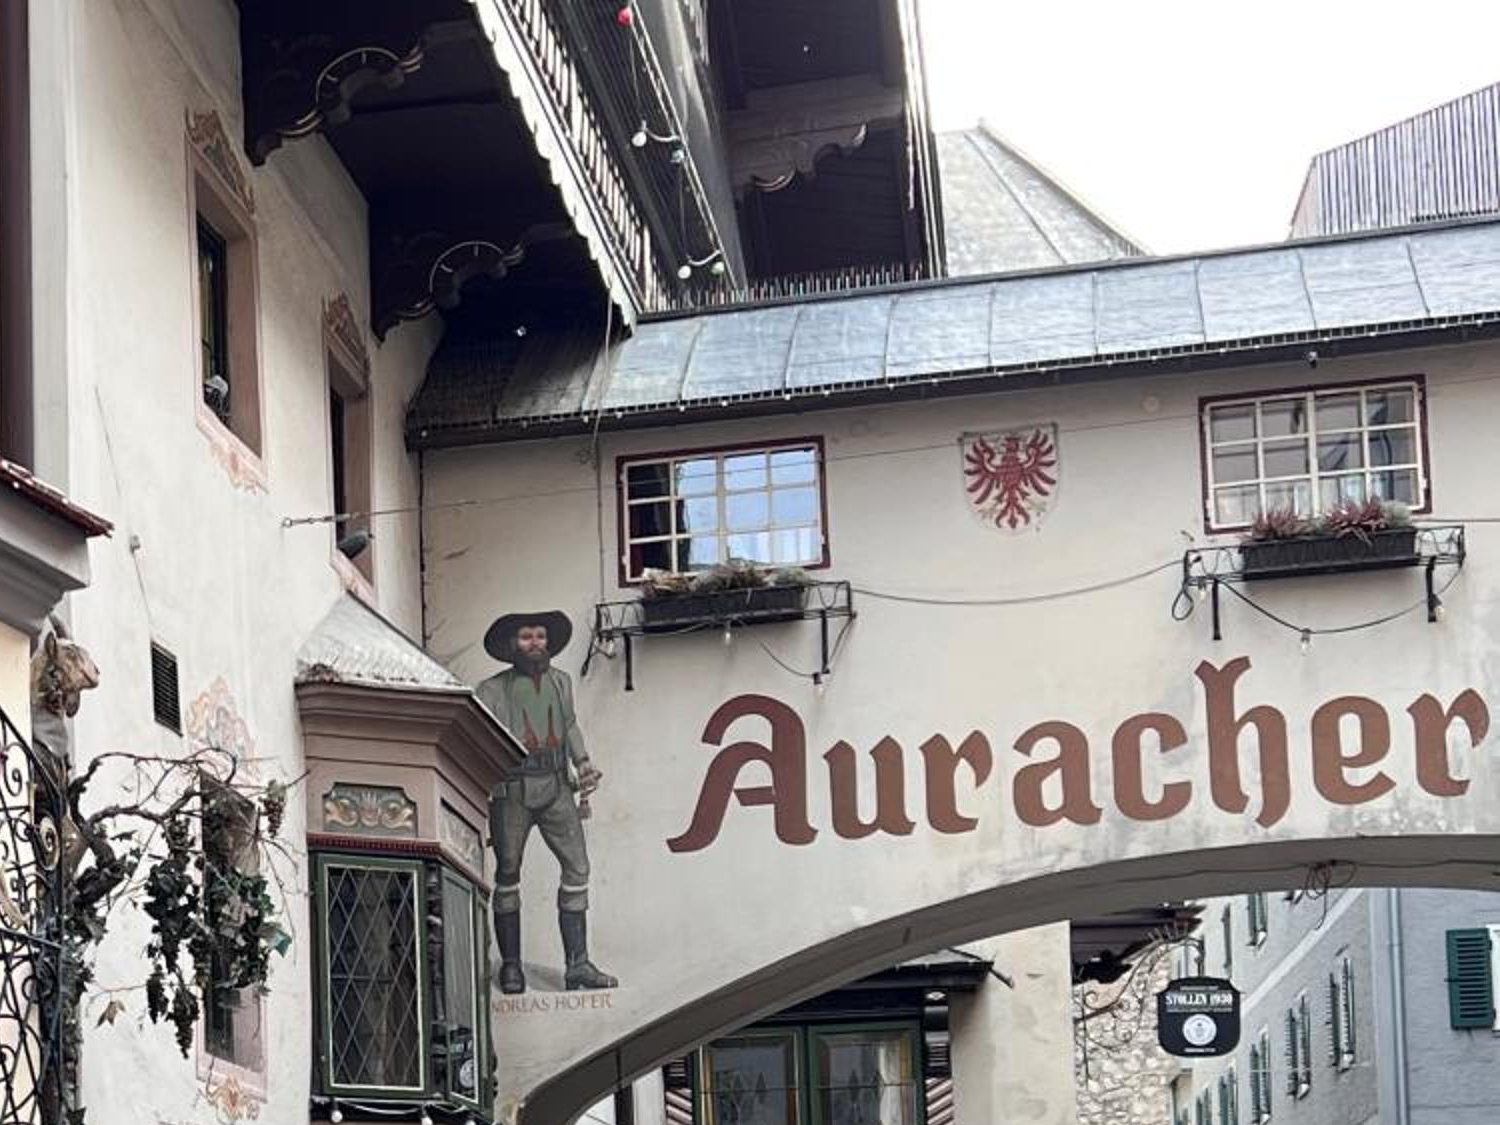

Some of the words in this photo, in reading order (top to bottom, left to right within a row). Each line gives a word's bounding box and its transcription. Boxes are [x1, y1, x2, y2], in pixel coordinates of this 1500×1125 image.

[666, 656, 1490, 854] Auracher
[555, 991, 613, 1010] HOFER
[1165, 991, 1208, 1005] STOLLEN
